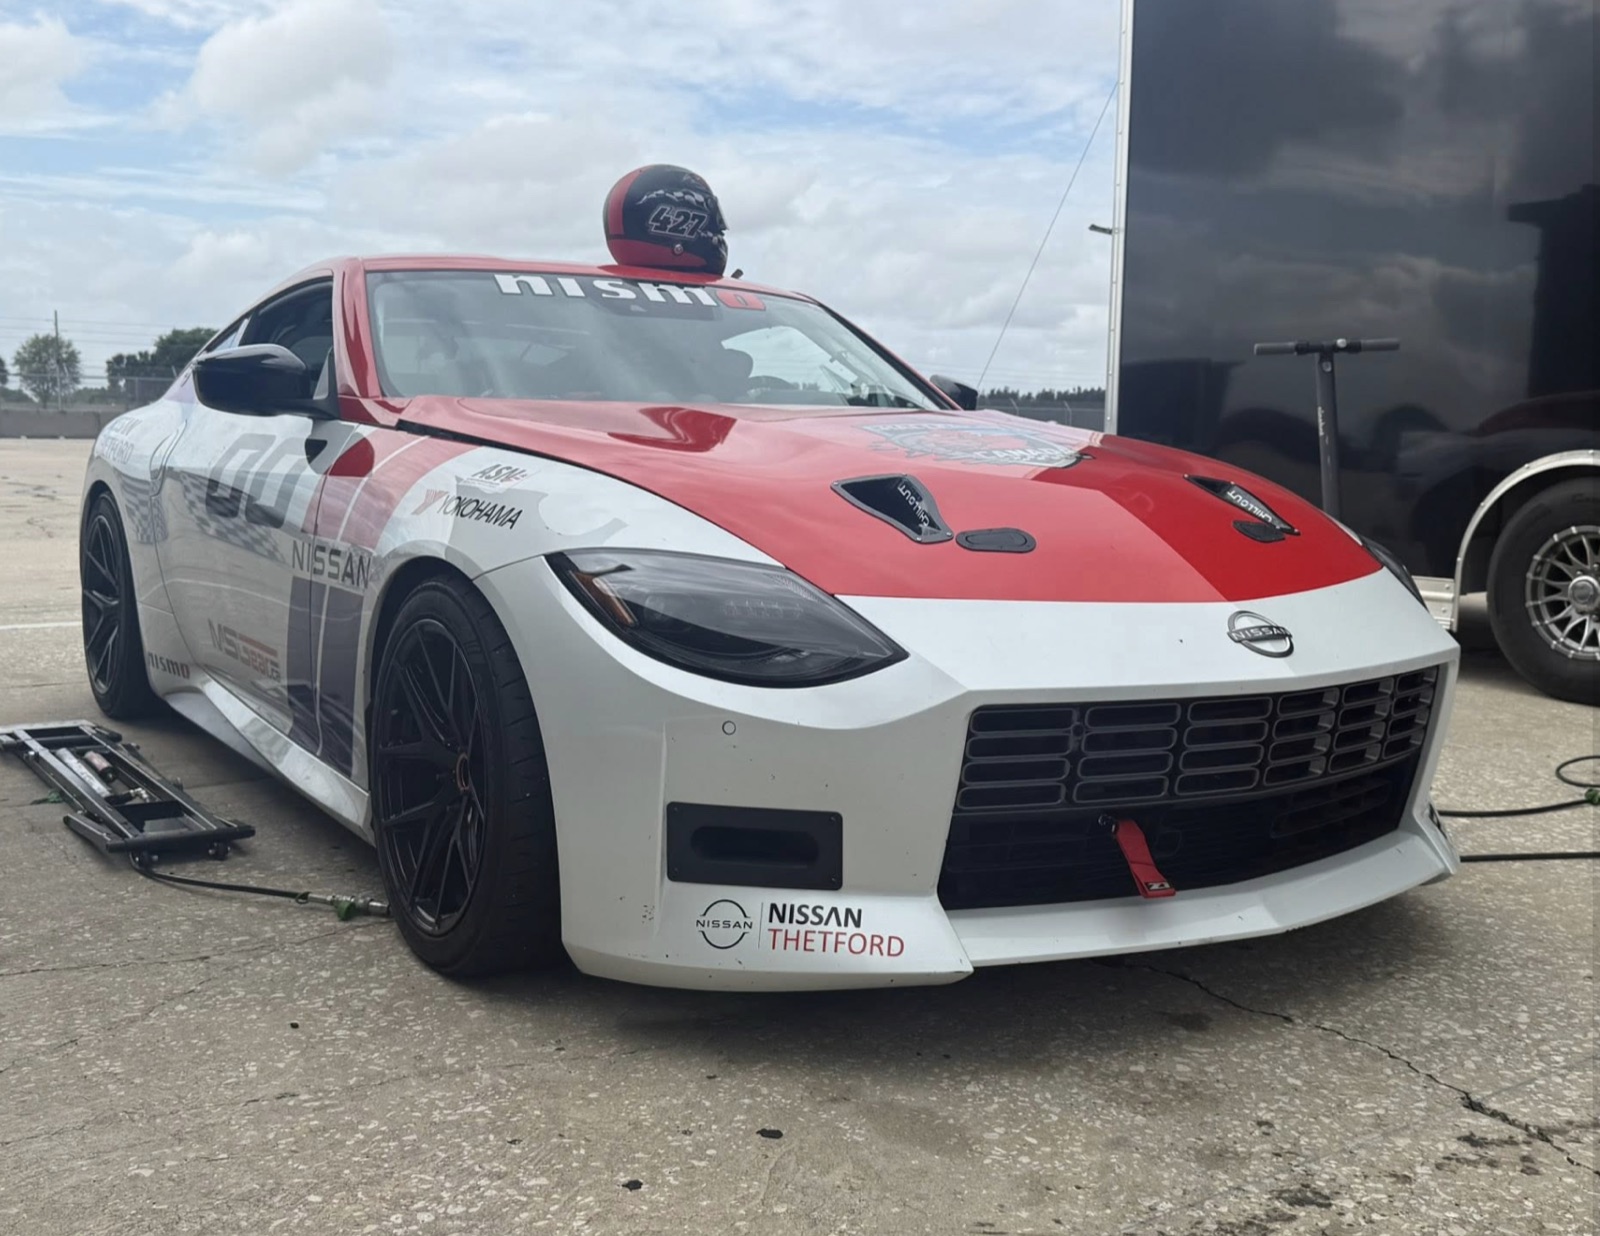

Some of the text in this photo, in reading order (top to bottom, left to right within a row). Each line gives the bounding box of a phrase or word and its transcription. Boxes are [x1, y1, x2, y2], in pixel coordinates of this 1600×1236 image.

[648, 205, 708, 239] 427
[494, 274, 767, 311] nismo
[437, 494, 523, 530] YOKOHAMA
[292, 540, 371, 589] NISSAN
[696, 919, 753, 930] NISSAN
[768, 903, 862, 928] NISSAN
[768, 928, 905, 957] THETFORD
